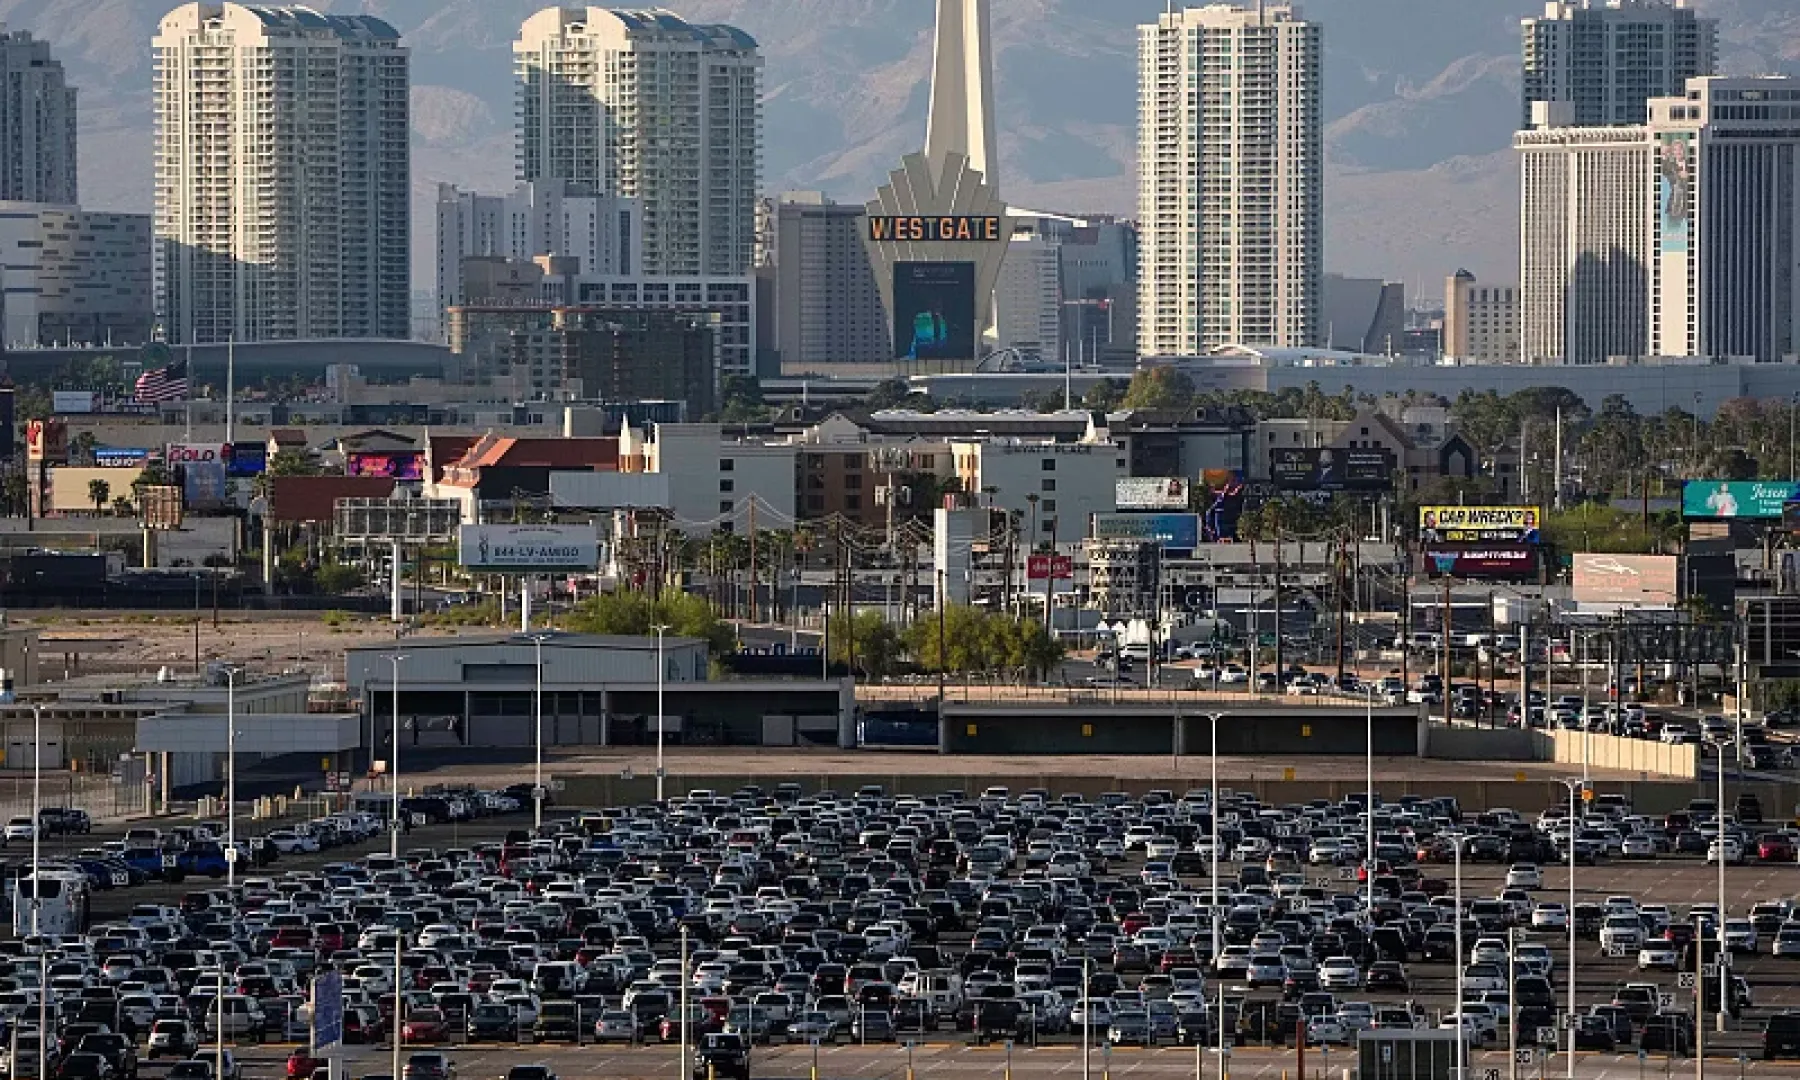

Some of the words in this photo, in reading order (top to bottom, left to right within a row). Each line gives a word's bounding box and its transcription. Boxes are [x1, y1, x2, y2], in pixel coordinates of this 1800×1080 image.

[871, 217, 998, 239] WESTGATE
[1750, 484, 1787, 500] Jesus
[1440, 510, 1466, 523] CAR
[494, 546, 579, 557] 844-LV-AMIGO
